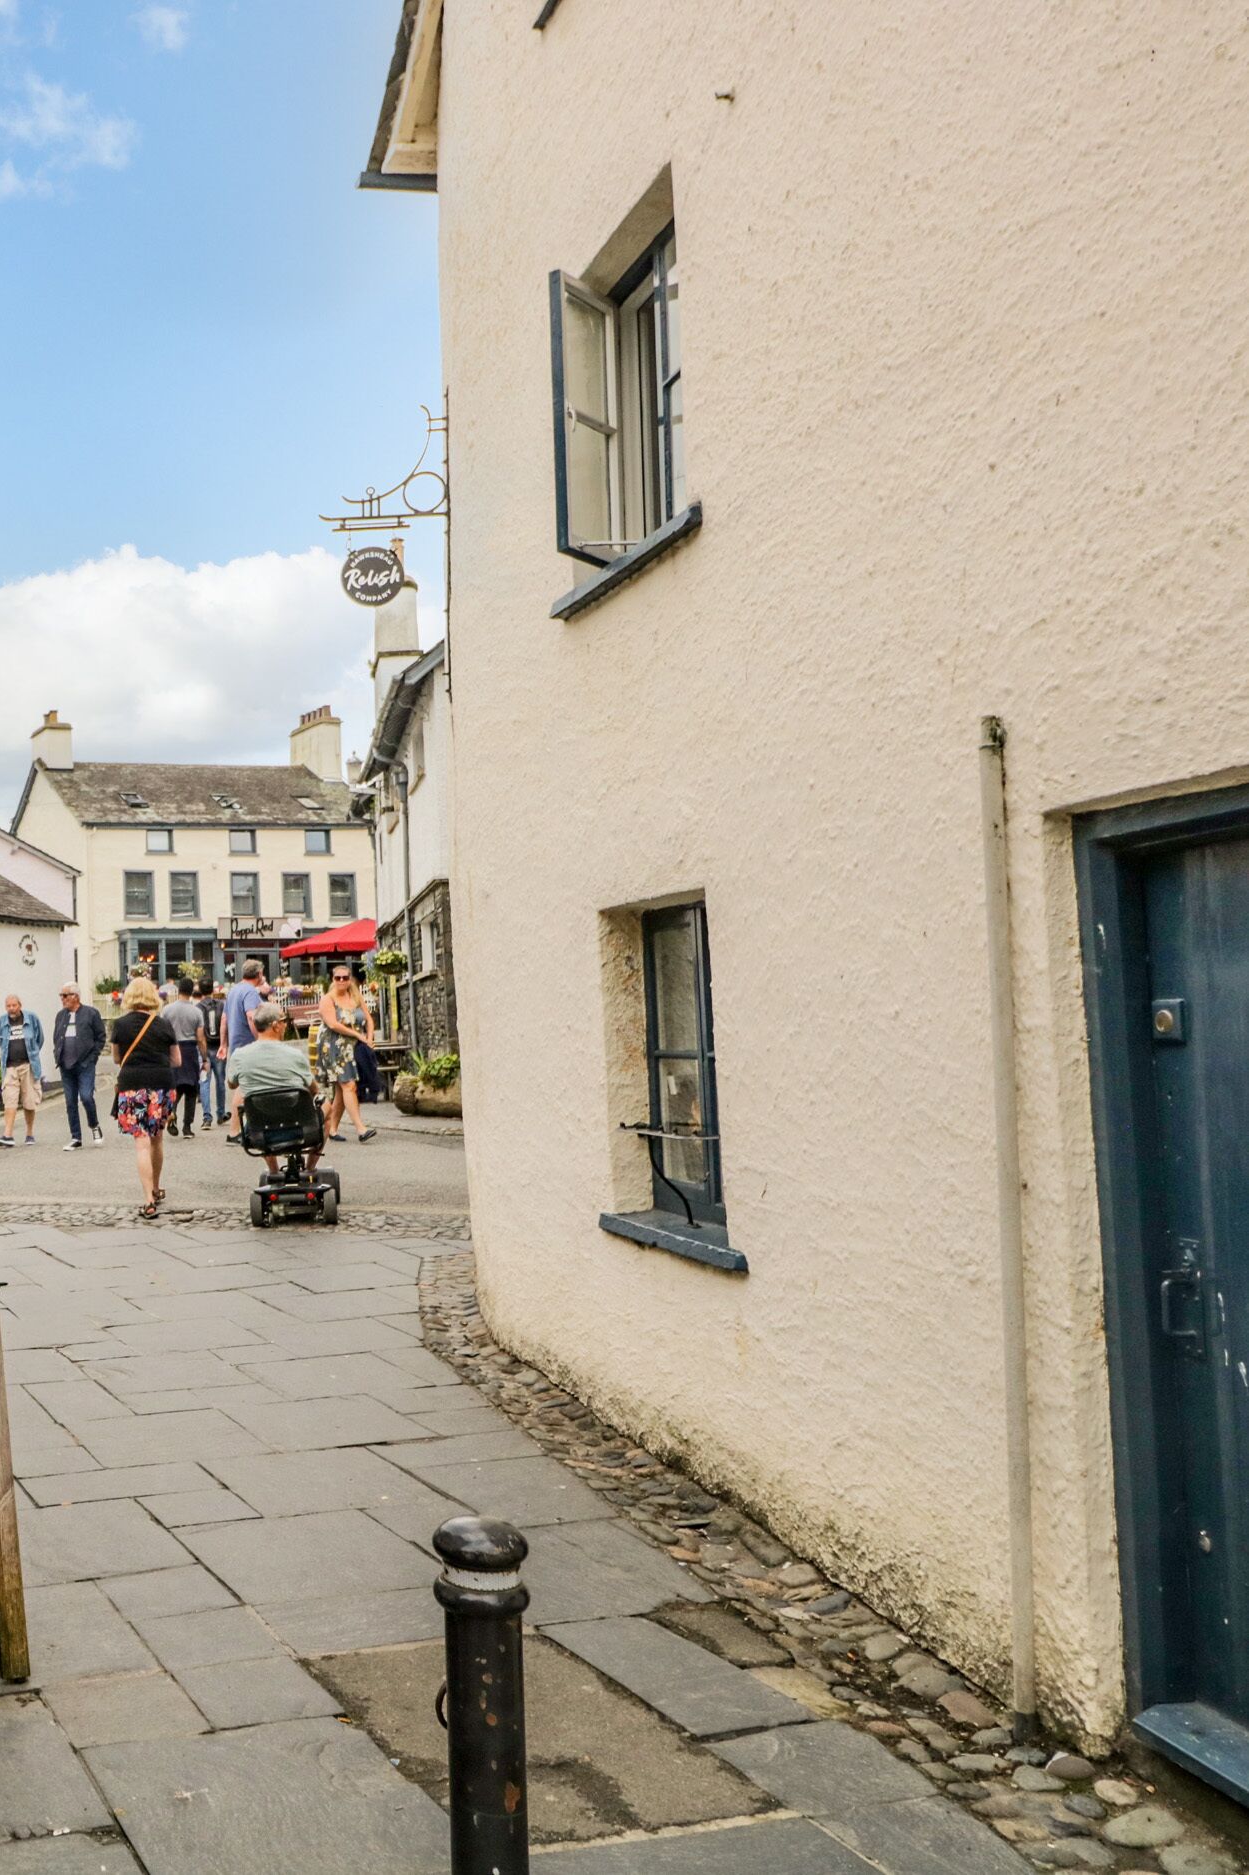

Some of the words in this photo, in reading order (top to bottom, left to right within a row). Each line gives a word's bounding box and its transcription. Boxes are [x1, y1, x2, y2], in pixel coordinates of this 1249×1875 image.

[344, 565, 400, 590] Relish
[355, 589, 391, 602] COMPANY
[230, 917, 254, 940] Poppi
[256, 917, 274, 937] Red
